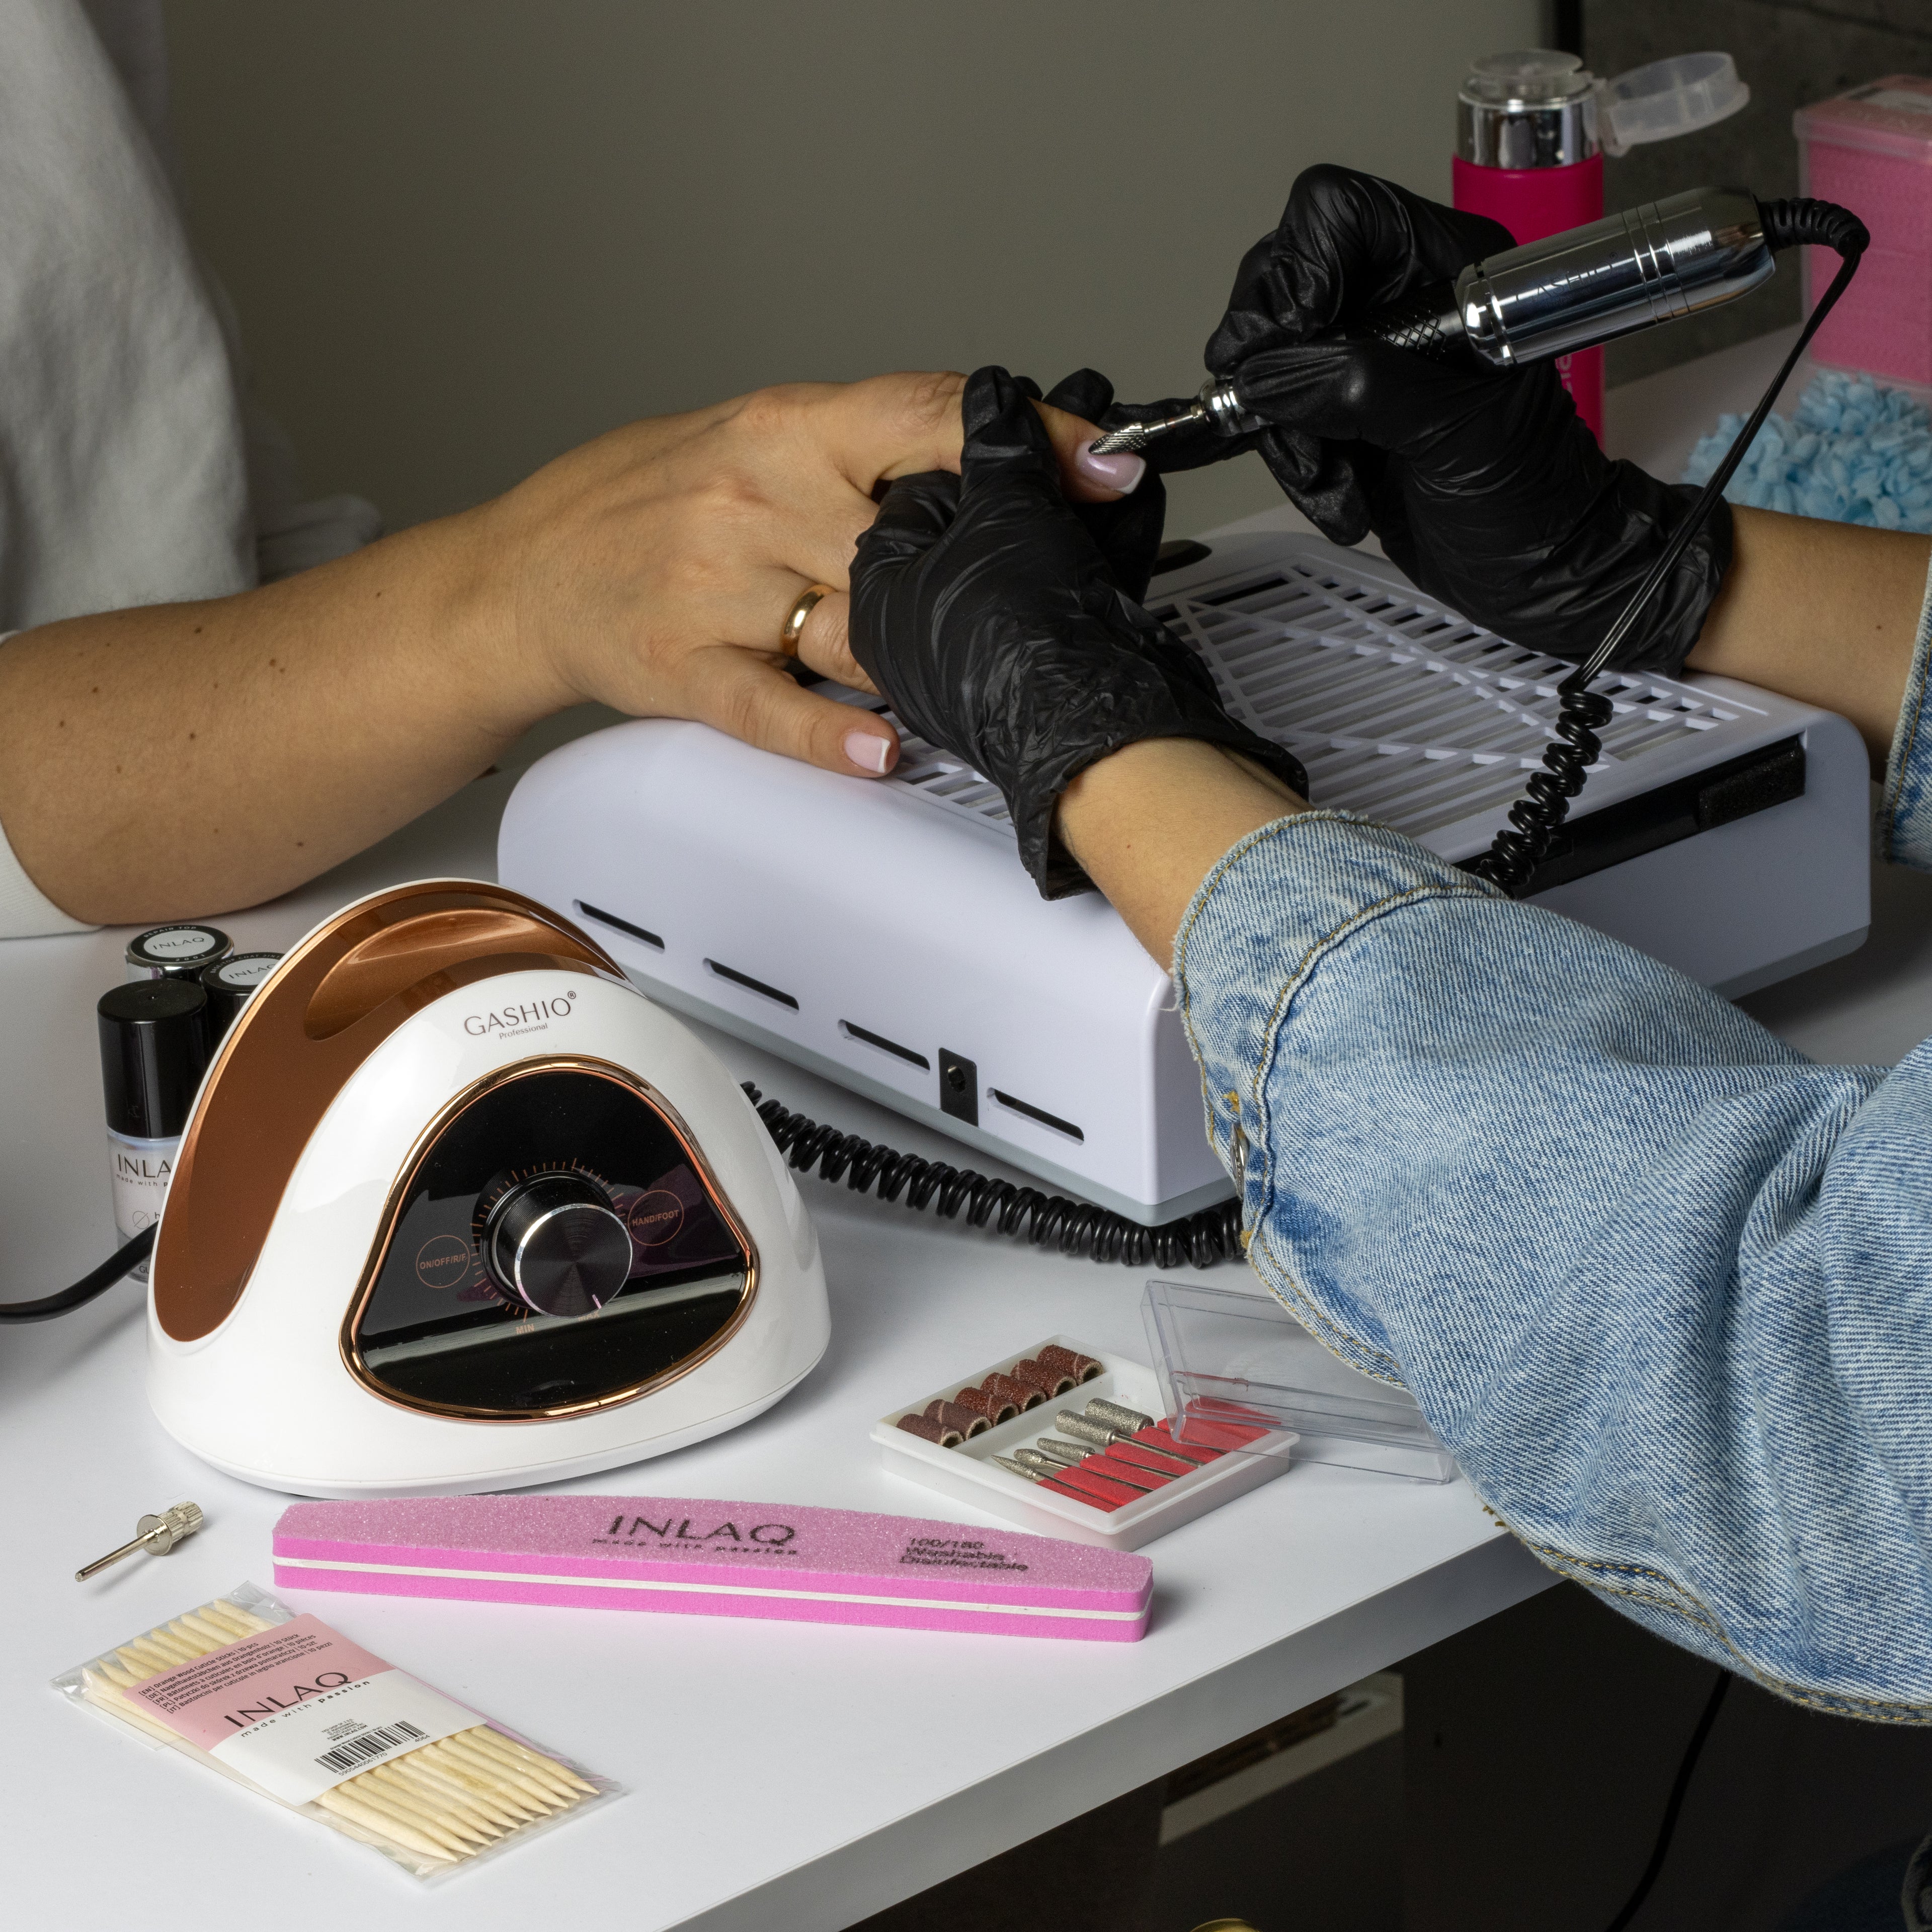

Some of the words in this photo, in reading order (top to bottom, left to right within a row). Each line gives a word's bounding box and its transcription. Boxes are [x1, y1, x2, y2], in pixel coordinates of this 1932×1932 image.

[144, 927, 174, 937] REPAIR
[153, 937, 204, 950] INLAQ
[499, 1022, 548, 1039] Professional
[118, 1154, 171, 1178] INLA
[116, 1174, 133, 1183] made
[632, 1210, 679, 1226] HAND/FOOT
[420, 1253, 466, 1269] ON/OFF/R/F
[515, 1324, 535, 1334] MIN
[609, 1515, 795, 1546] INLAQ
[592, 1538, 647, 1547] made
[715, 1546, 797, 1556] passion
[910, 1538, 985, 1550] 100/180
[906, 1547, 1005, 1561] Washable
[899, 1555, 1028, 1571] Disinfectable
[138, 1686, 155, 1696] [EN]
[153, 1676, 177, 1688] Orange
[176, 1668, 195, 1677] Wood
[194, 1659, 216, 1670] Cuticle
[215, 1651, 235, 1661] Sticks
[238, 1642, 259, 1652] 10-pcs
[145, 1691, 162, 1701] [DE]
[160, 1665, 221, 1693] Nagelhautstäbchen
[232, 1644, 272, 1662] Orangenholz
[281, 1634, 300, 1642] Stück
[152, 1695, 169, 1705] [FR]
[206, 1666, 233, 1680] cuticules
[241, 1657, 257, 1665] bois
[293, 1634, 316, 1647] pièces
[159, 1699, 175, 1709] [PL]
[174, 1687, 201, 1702] Patyczki
[209, 1674, 232, 1688] skórek
[235, 1664, 258, 1675] drzewa
[258, 1648, 296, 1666] pomarańczy
[297, 1641, 318, 1650] 10-szt
[167, 1705, 181, 1714] [IT]
[179, 1689, 213, 1707] Bastoncini
[223, 1674, 250, 1687] cuticole
[255, 1663, 275, 1674] legno
[275, 1651, 306, 1665] arancione
[315, 1642, 333, 1651] pezzi
[224, 1672, 352, 1728] INLAQ
[241, 1719, 276, 1737] made
[282, 1703, 312, 1718] with
[317, 1680, 370, 1703] passion
[332, 1725, 368, 1741] WWW.INLAQ.COM
[338, 1752, 388, 1776] 5905440061770
[415, 1734, 431, 1743] 4064
